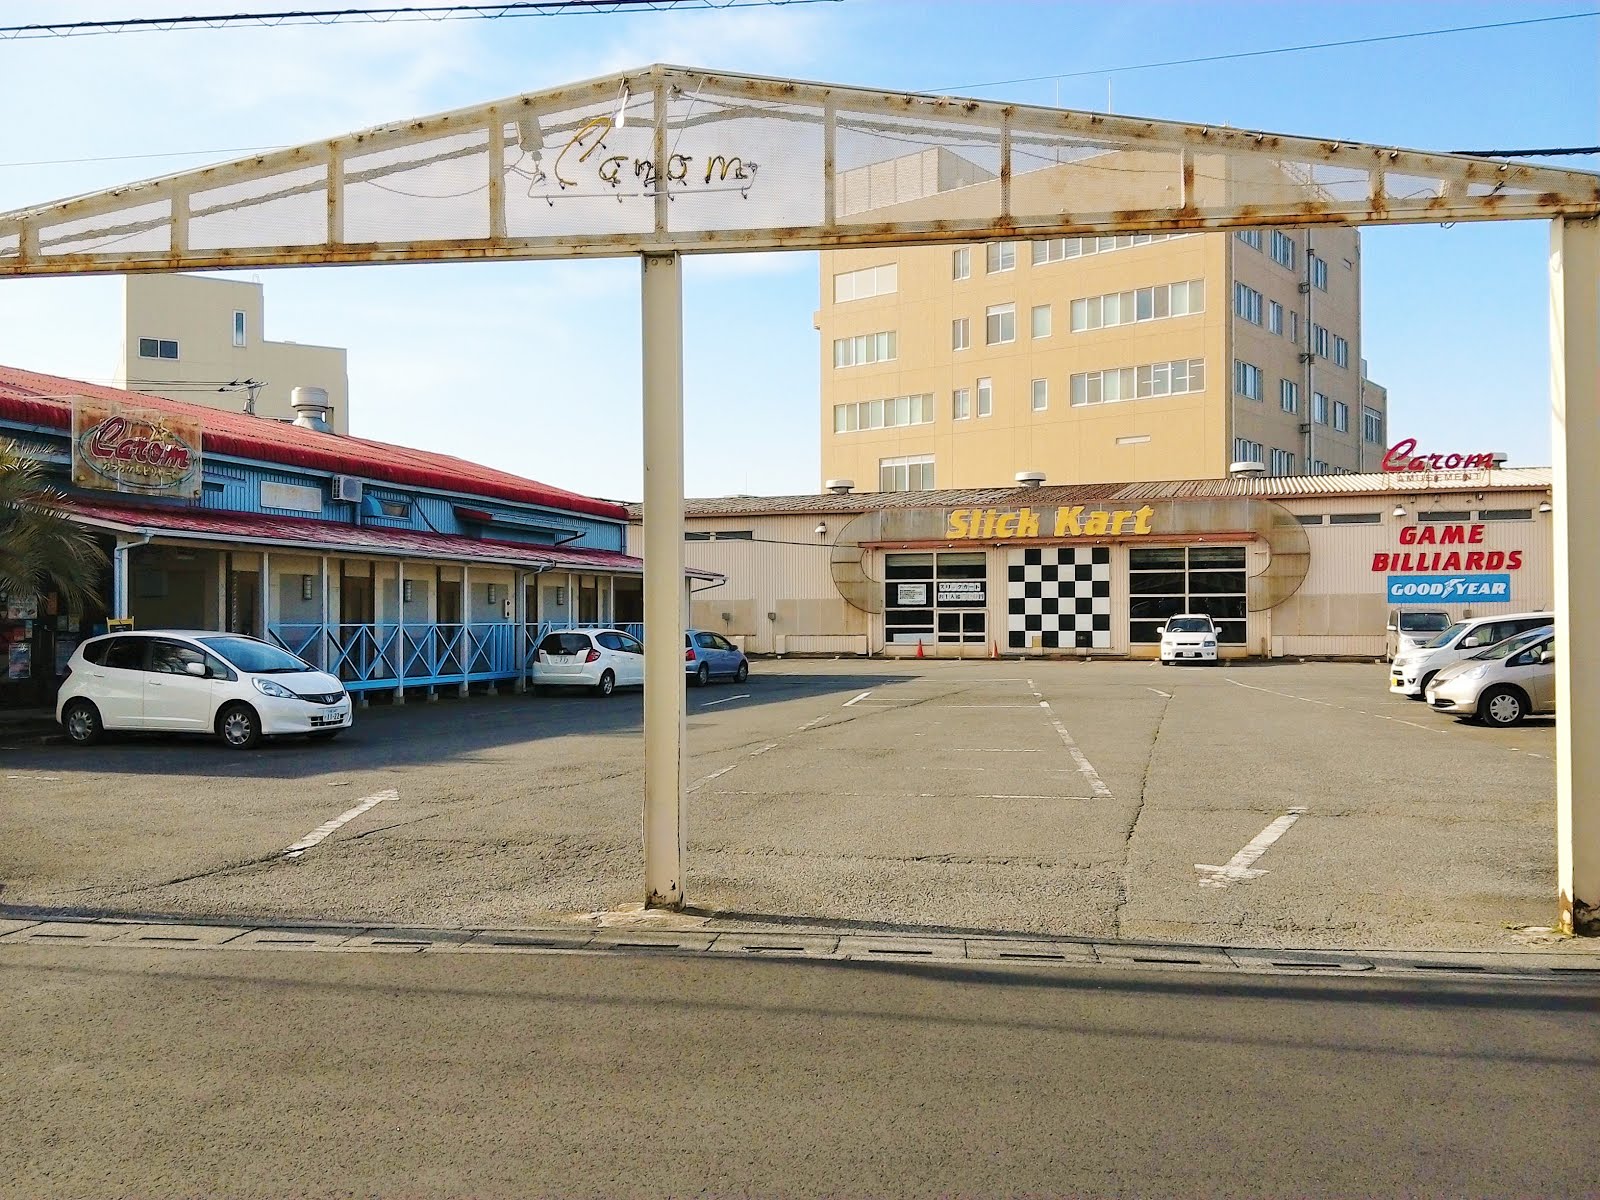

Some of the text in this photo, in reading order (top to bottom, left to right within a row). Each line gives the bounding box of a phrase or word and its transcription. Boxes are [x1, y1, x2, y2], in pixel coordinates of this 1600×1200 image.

[91, 416, 190, 469] Carom
[1382, 438, 1494, 472] Carom
[946, 505, 1154, 539] Slick Kart
[1399, 524, 1485, 545] GAME
[1371, 550, 1523, 572] BILLIARDS
